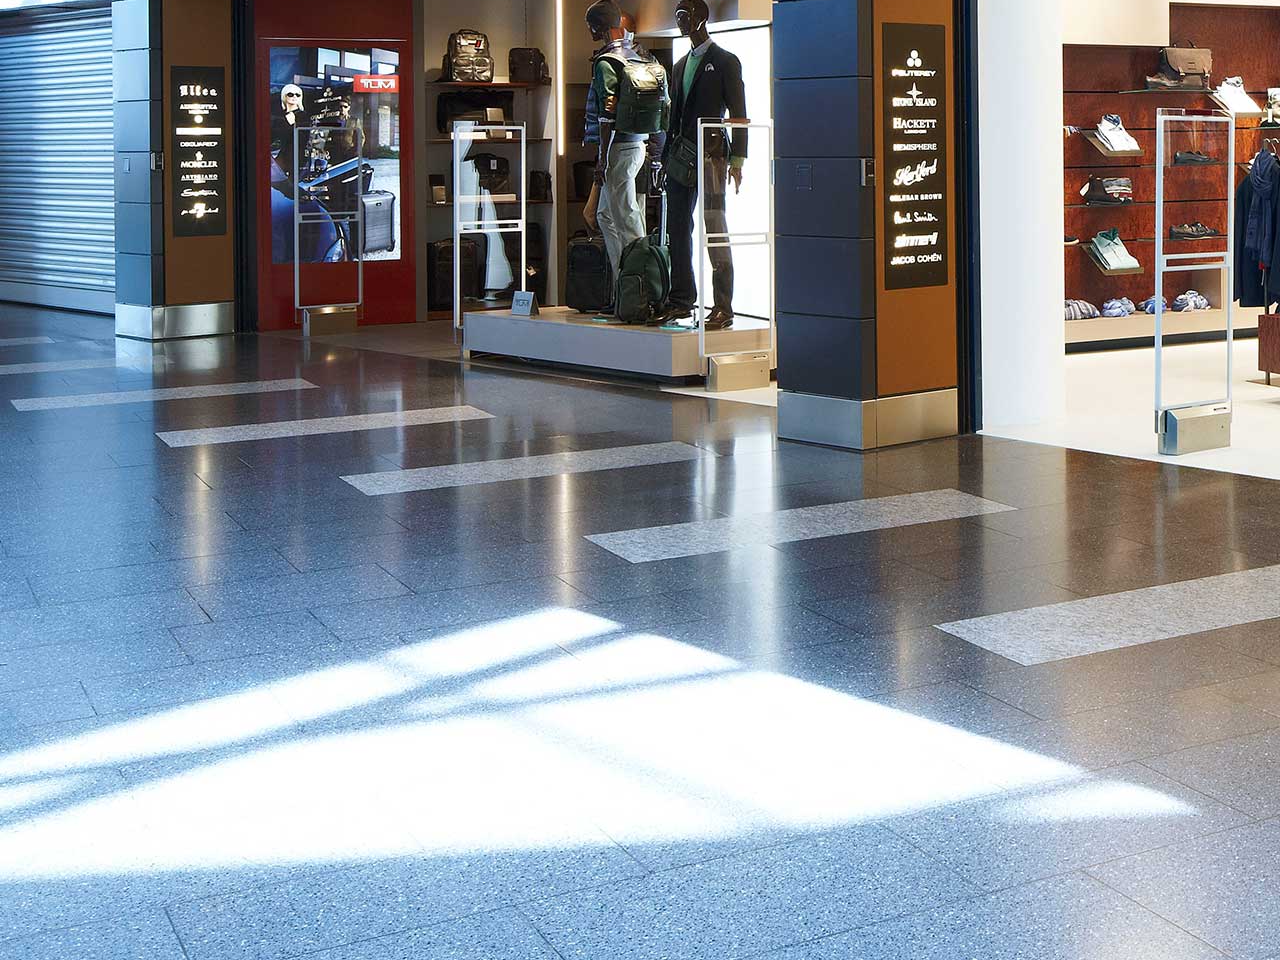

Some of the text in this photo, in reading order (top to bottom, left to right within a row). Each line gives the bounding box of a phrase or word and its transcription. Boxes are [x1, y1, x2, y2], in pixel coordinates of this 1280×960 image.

[360, 78, 396, 88] TUMI
[915, 97, 937, 107] ISLAND
[892, 117, 937, 129] HACKETT
[892, 143, 938, 152] HEMISPHERE
[180, 160, 218, 169] MONCLER
[919, 193, 943, 201] BROWN
[890, 256, 916, 265] JACOB
